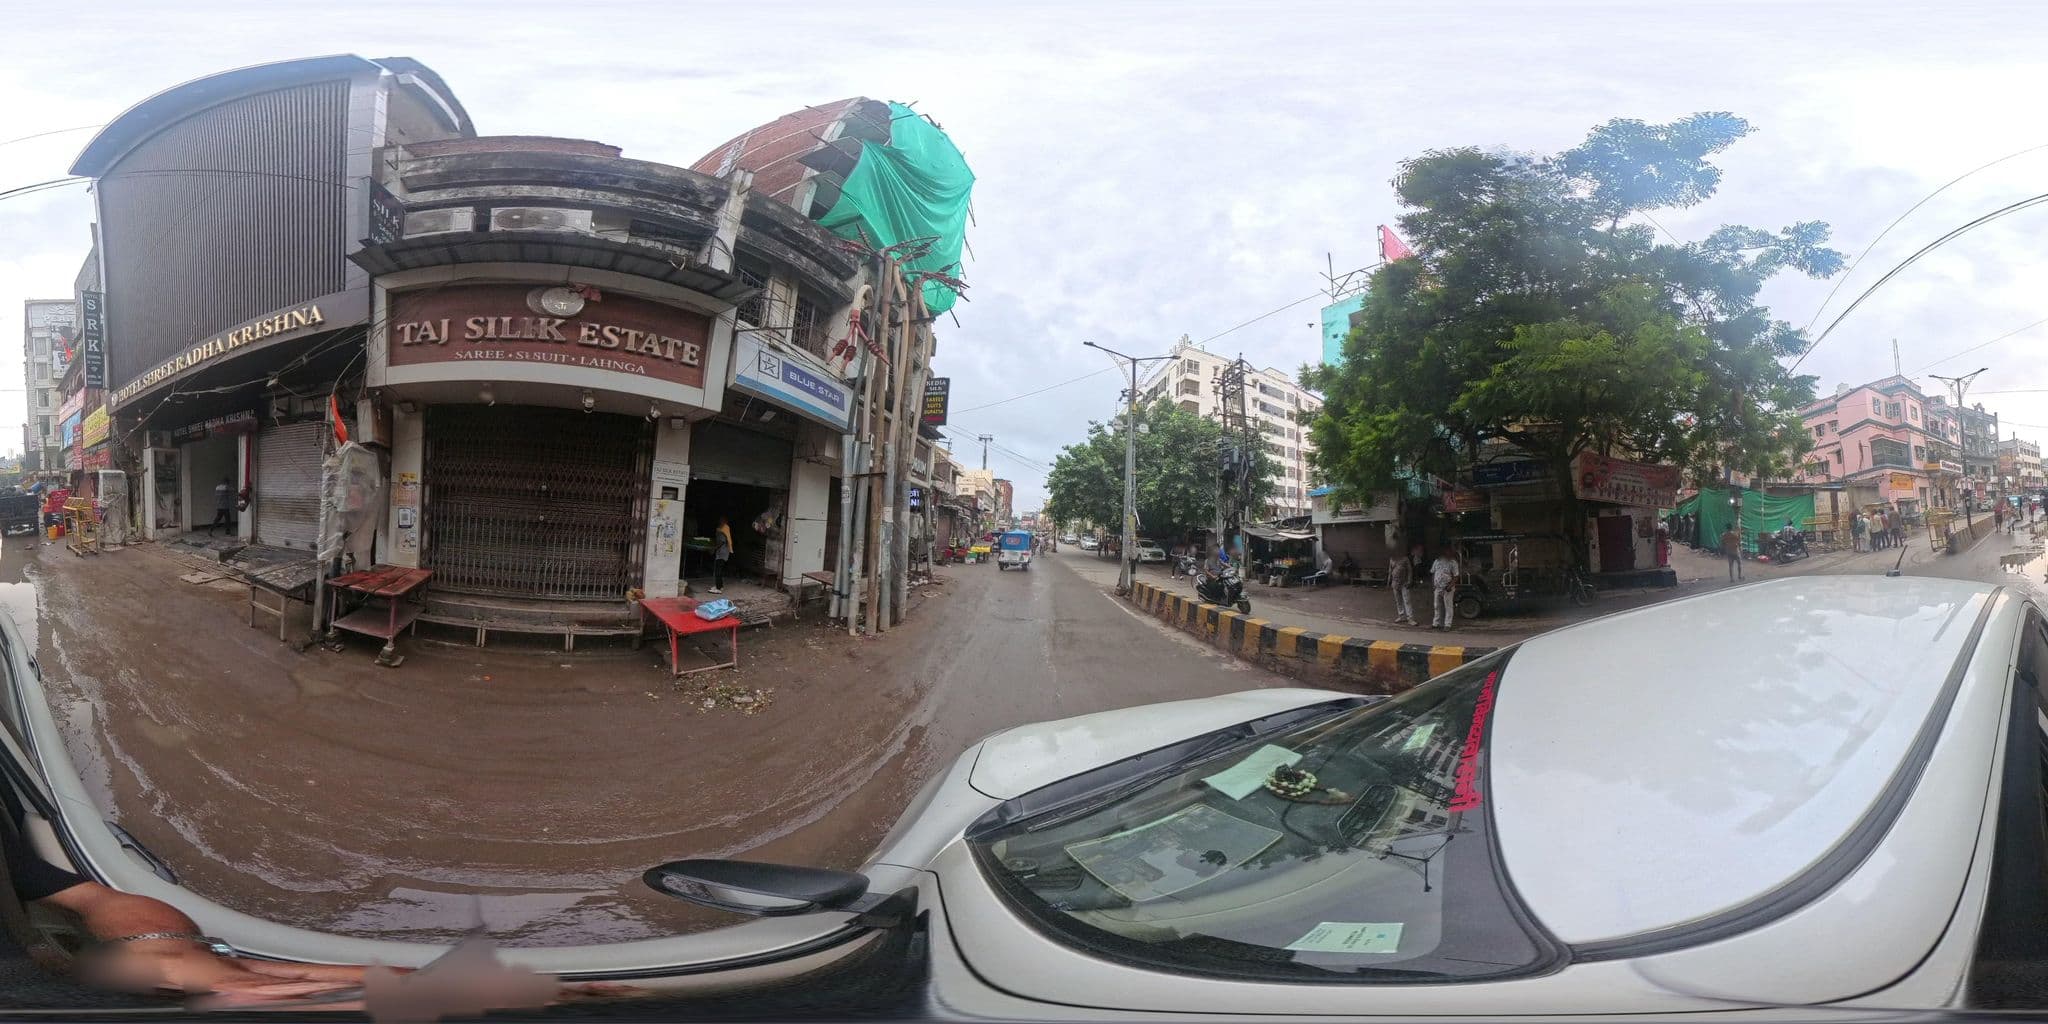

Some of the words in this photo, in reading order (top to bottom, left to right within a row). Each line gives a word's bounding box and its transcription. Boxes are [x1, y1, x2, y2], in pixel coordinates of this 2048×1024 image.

[118, 379, 145, 402] HOTEL
[142, 360, 176, 388] SHREE
[175, 337, 226, 372] RADHA
[227, 305, 324, 348] KRISHNA
[397, 318, 450, 345] TAJ
[578, 322, 700, 367] ESTATE
[455, 350, 505, 360] SAREE
[580, 356, 646, 375] LAHNGA
[789, 371, 816, 390] BLUE
[818, 386, 840, 402] STAR
